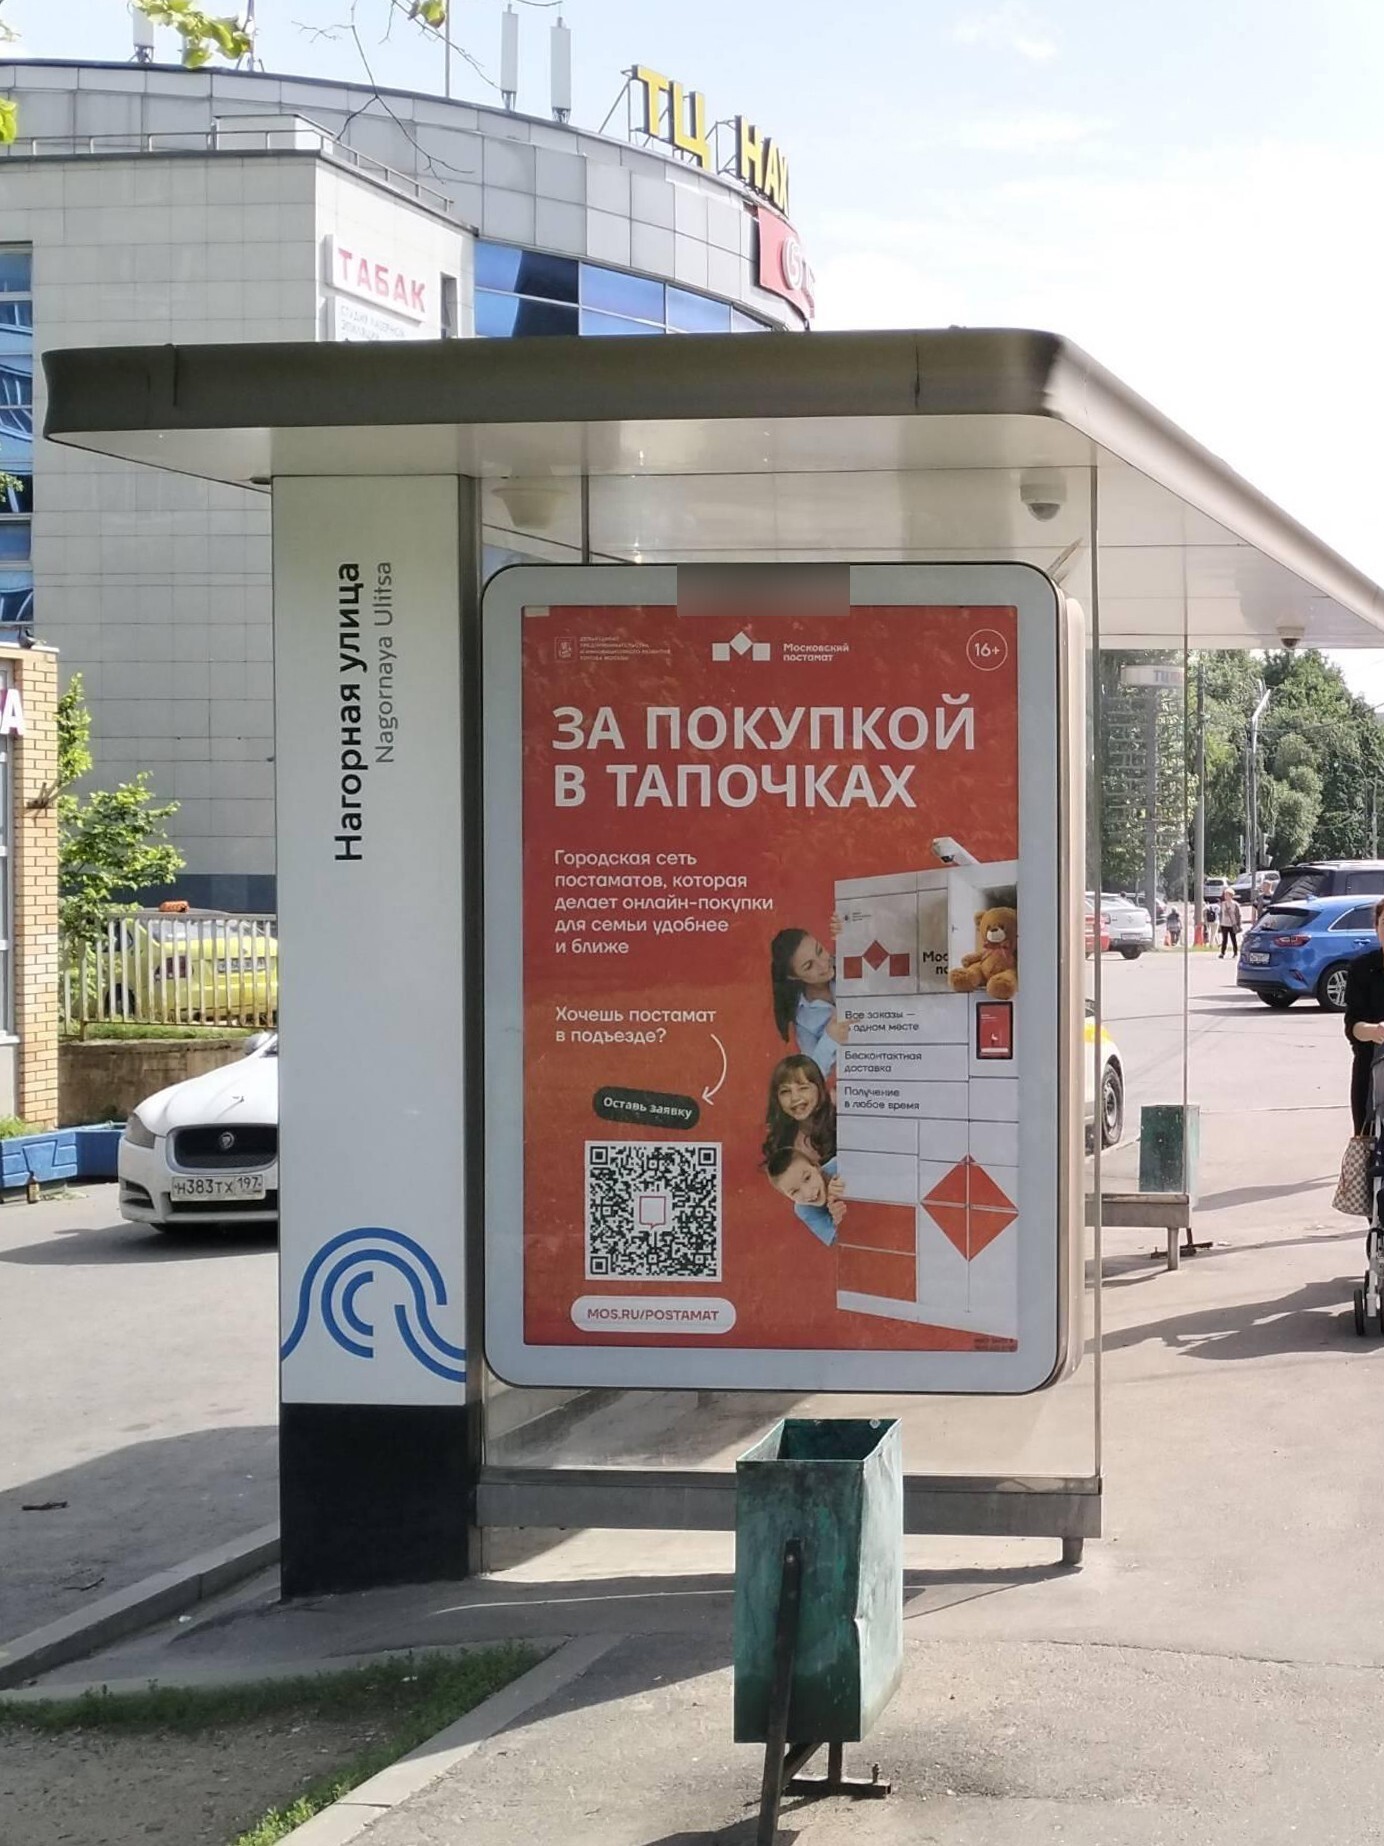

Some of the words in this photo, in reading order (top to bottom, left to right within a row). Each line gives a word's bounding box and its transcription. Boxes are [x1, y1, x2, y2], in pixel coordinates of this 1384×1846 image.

[631, 65, 711, 170] ТЦ
[338, 247, 425, 314] ТАБАК
[373, 562, 393, 626] Ulitsa
[338, 562, 367, 672] улица
[783, 643, 850, 653] Московский
[974, 642, 1000, 659] 16+
[783, 653, 834, 662] постамат
[375, 636, 398, 763] Nagornaya
[552, 706, 625, 751] ЗА
[645, 693, 975, 751] ПОКУПКОЙ
[334, 684, 368, 860] Нагорная
[554, 765, 586, 808] В
[606, 764, 916, 809] ТАПОЧКАХ
[555, 850, 650, 868] Городская
[656, 852, 697, 865] сеть
[555, 875, 667, 889] постаматов,
[673, 875, 747, 890] которая
[555, 896, 618, 911] делает
[623, 895, 773, 912] онлайн-покупки
[555, 919, 586, 933] для
[592, 919, 647, 932] семьи
[653, 917, 729, 935] удобнее
[556, 942, 566, 953] и
[571, 938, 629, 954] ближе
[556, 1006, 624, 1021] Хочешь
[629, 1009, 716, 1022] постамат
[845, 1010, 865, 1019] Все
[867, 1010, 903, 1019] заказы
[556, 1031, 566, 1042] в
[571, 1027, 666, 1045] подъезде?
[853, 1023, 886, 1033] одном
[888, 1022, 919, 1031] месте
[844, 1050, 922, 1061] Бесконтактная
[844, 1063, 892, 1073] доставка
[844, 1086, 900, 1098] Получение
[603, 1096, 647, 1113] Оставь
[649, 1103, 692, 1120] заявку
[852, 1099, 885, 1110] любое
[888, 1101, 920, 1111] время
[587, 1308, 720, 1322] MOS.RU/POSTAMAT
